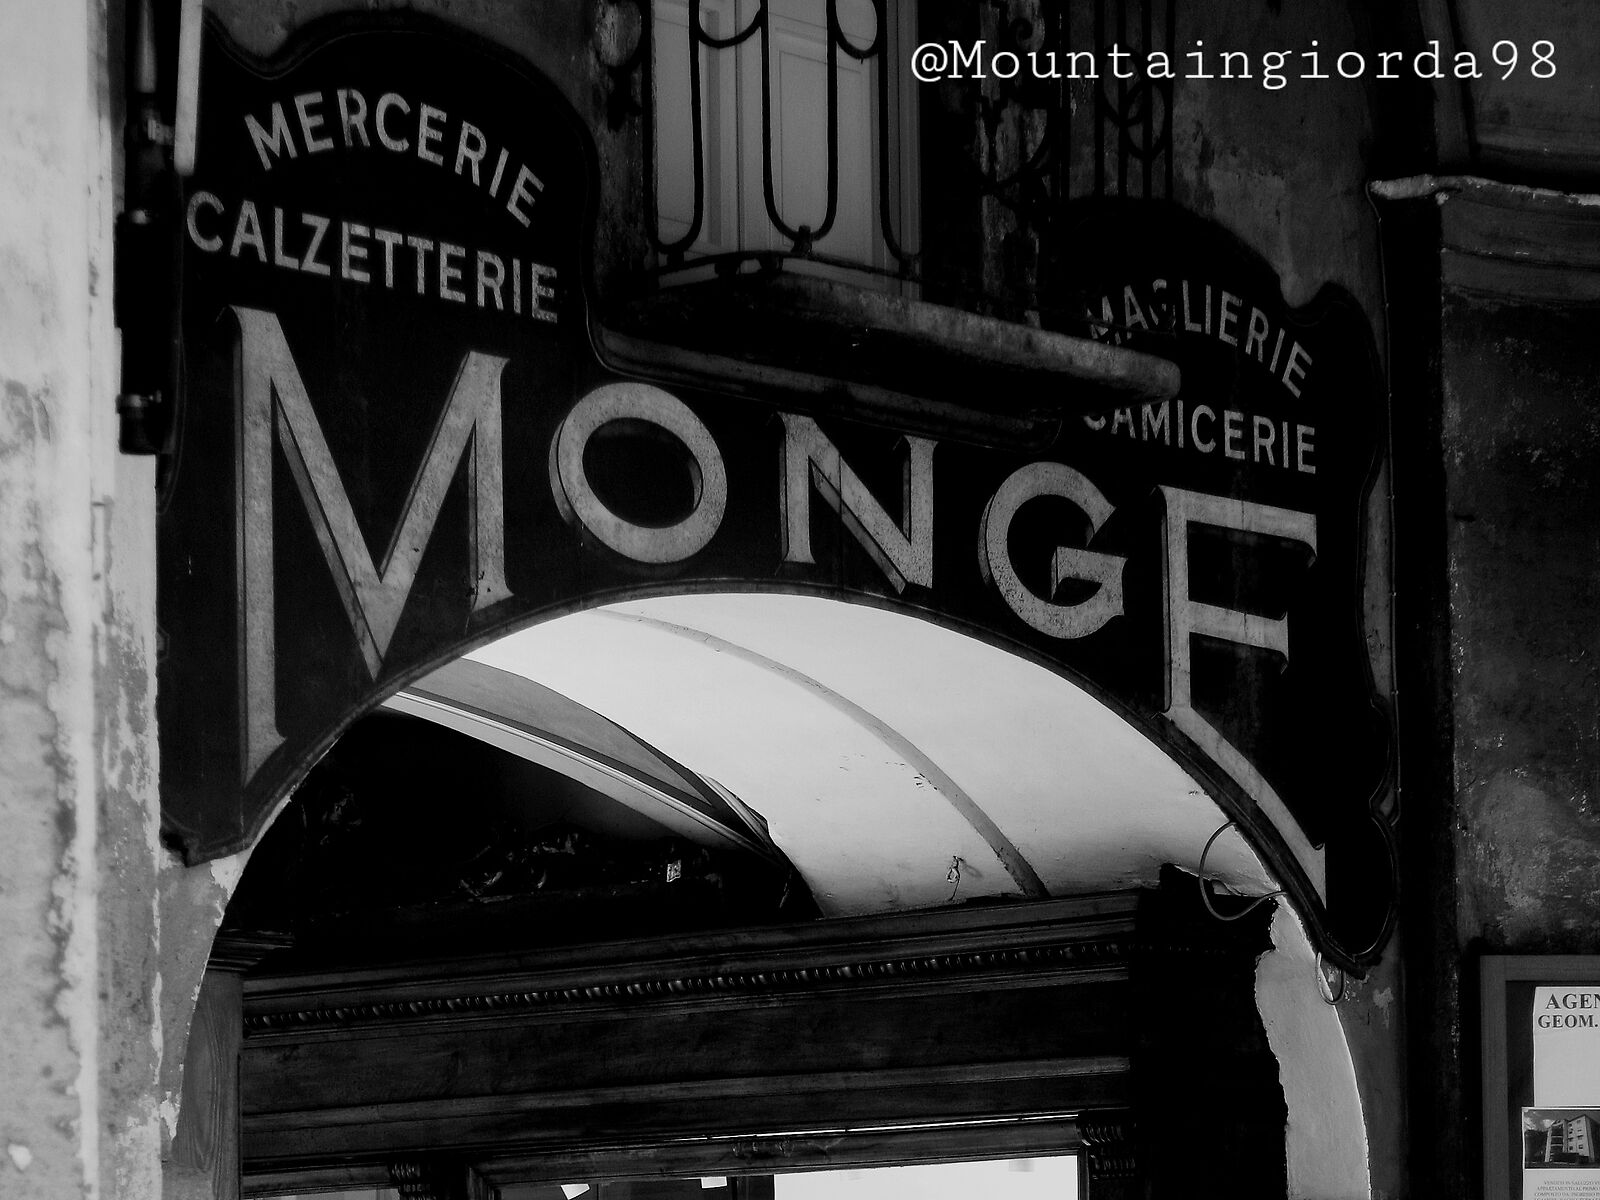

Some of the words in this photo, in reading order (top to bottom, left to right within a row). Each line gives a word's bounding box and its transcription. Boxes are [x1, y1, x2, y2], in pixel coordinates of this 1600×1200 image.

[244, 87, 546, 228] MERCERIE
[185, 190, 558, 324] CALZETTERIE
[228, 303, 1327, 909] MONGE
[1537, 1014, 1598, 1029] GEOM.
